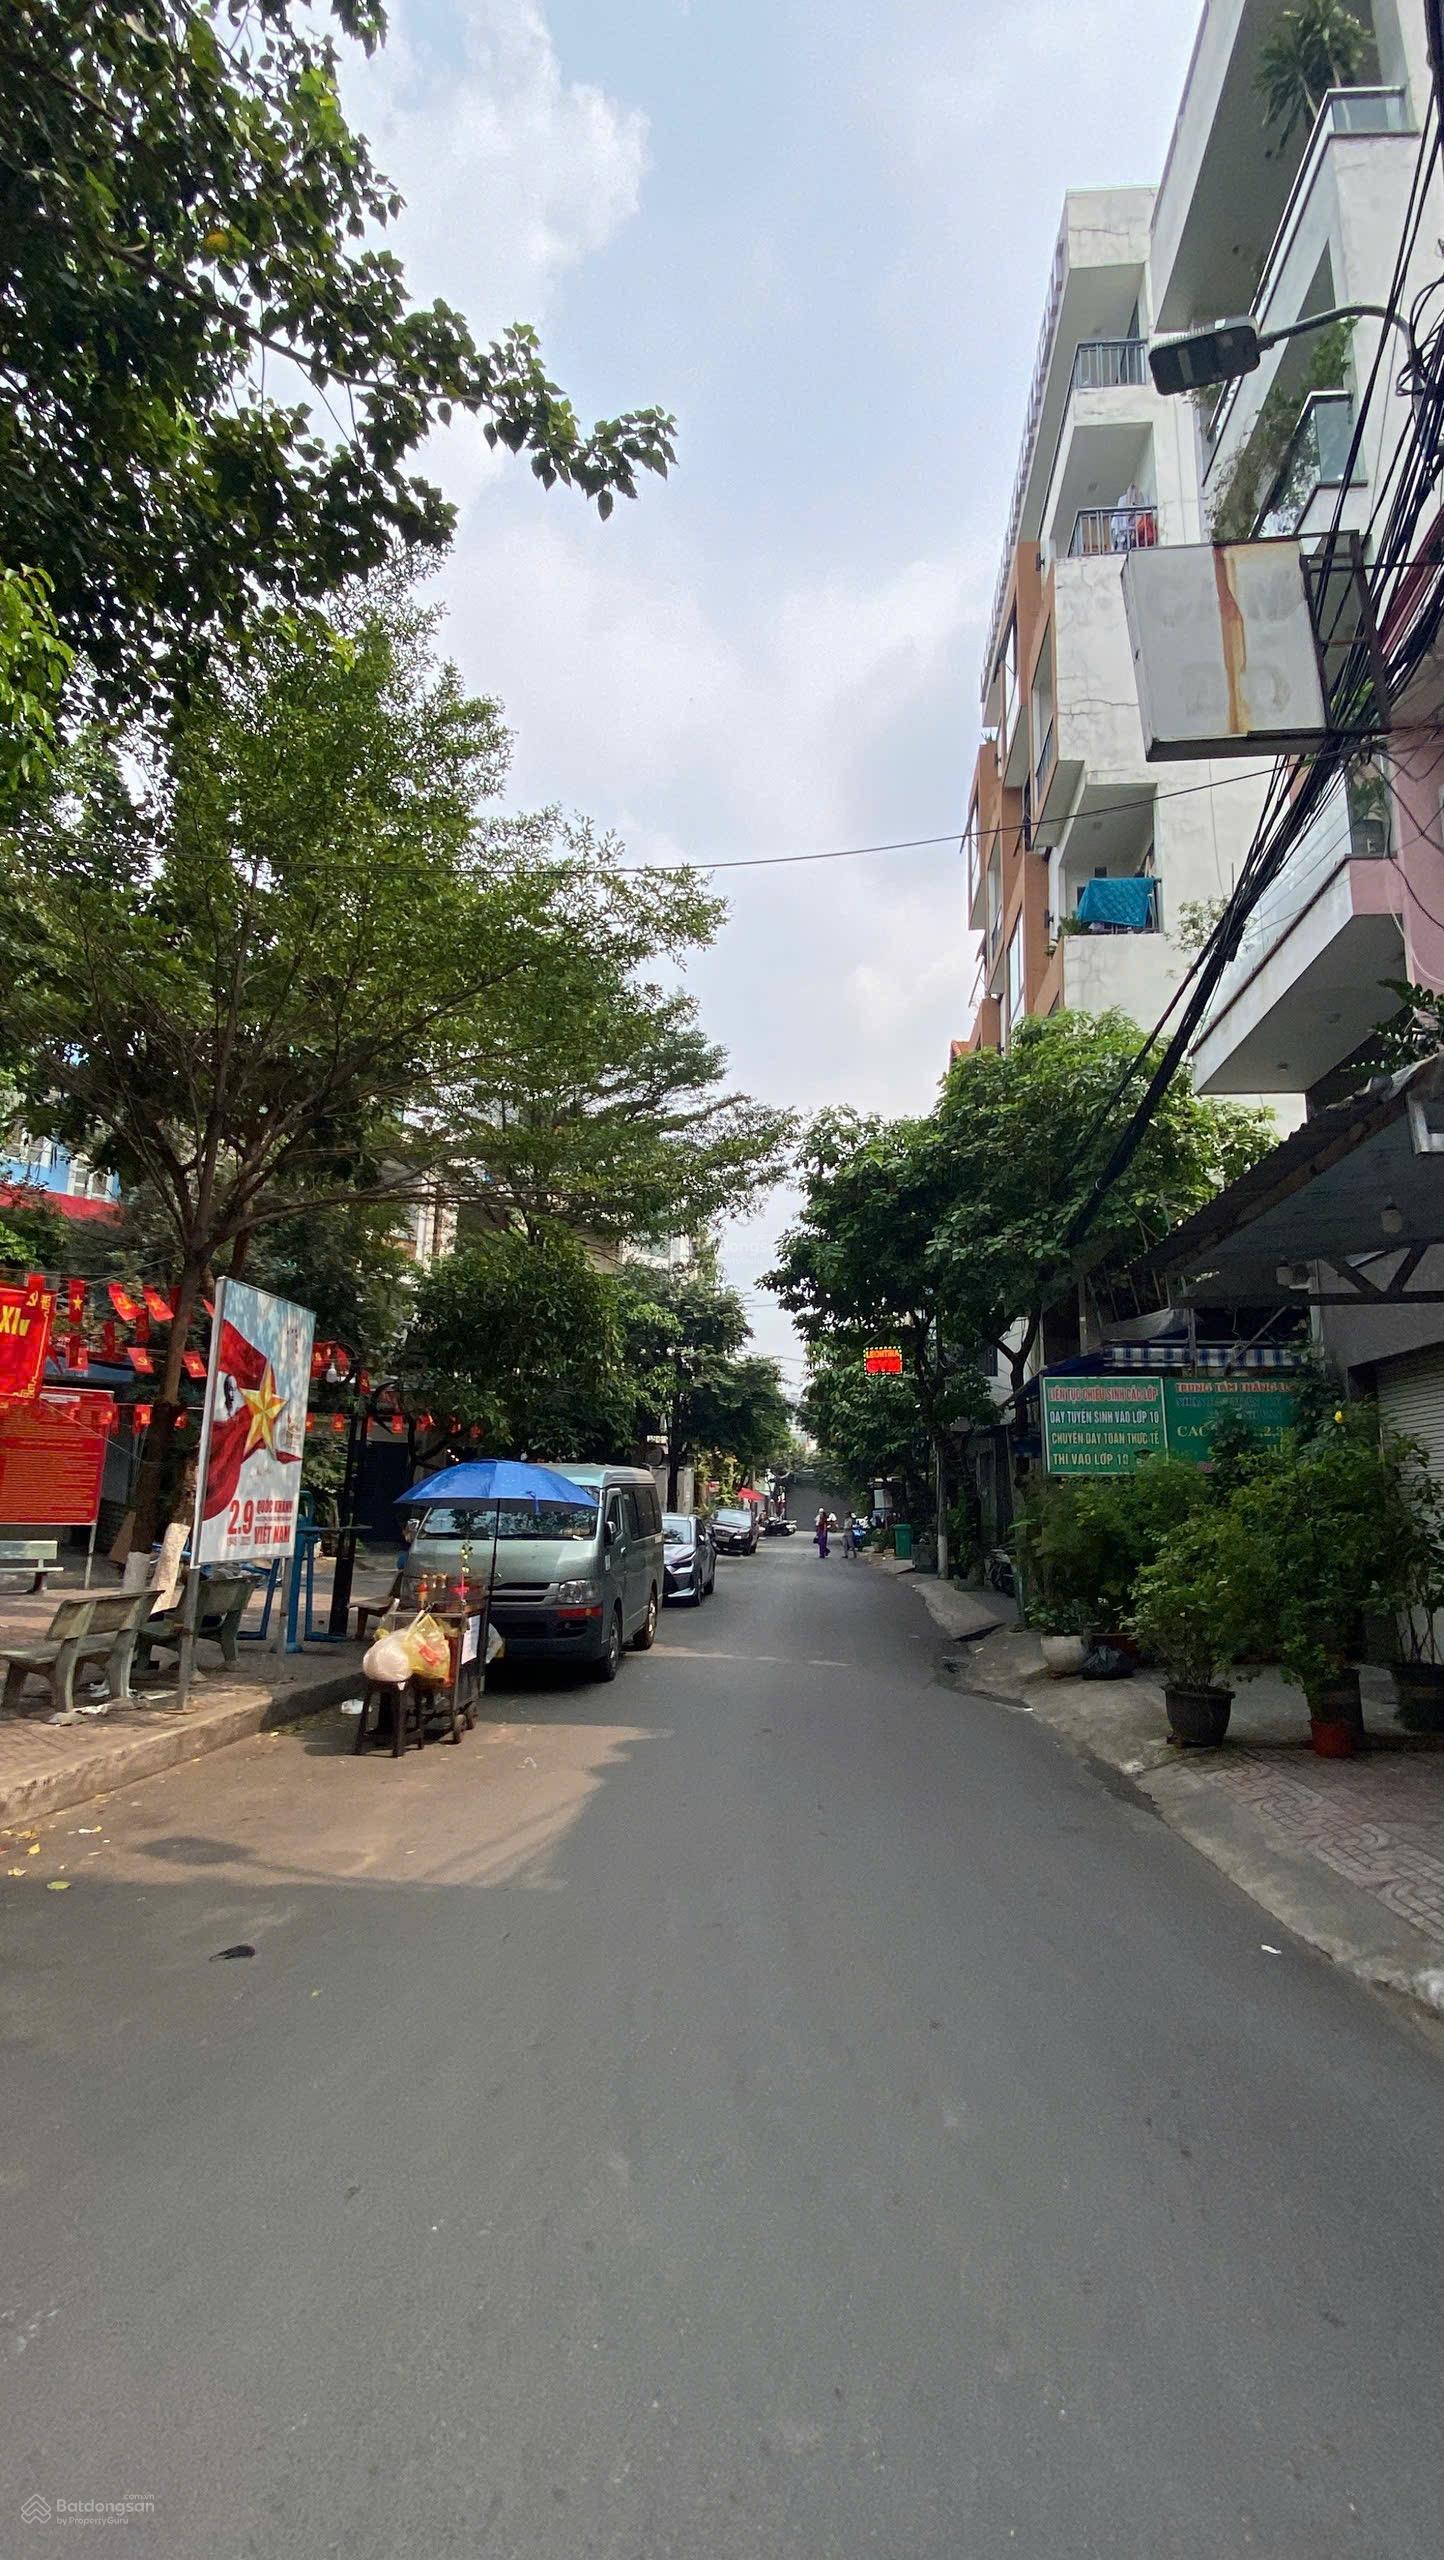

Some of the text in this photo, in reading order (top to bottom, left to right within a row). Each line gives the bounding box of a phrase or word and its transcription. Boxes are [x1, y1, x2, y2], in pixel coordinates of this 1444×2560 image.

[1094, 1410, 1113, 1424] SINH
[1149, 1411, 1160, 1424] 10
[1053, 1453, 1068, 1465] THI
[1117, 1453, 1129, 1465] 10
[227, 1499, 254, 1535] 2.9
[273, 1525, 291, 1544] NAM
